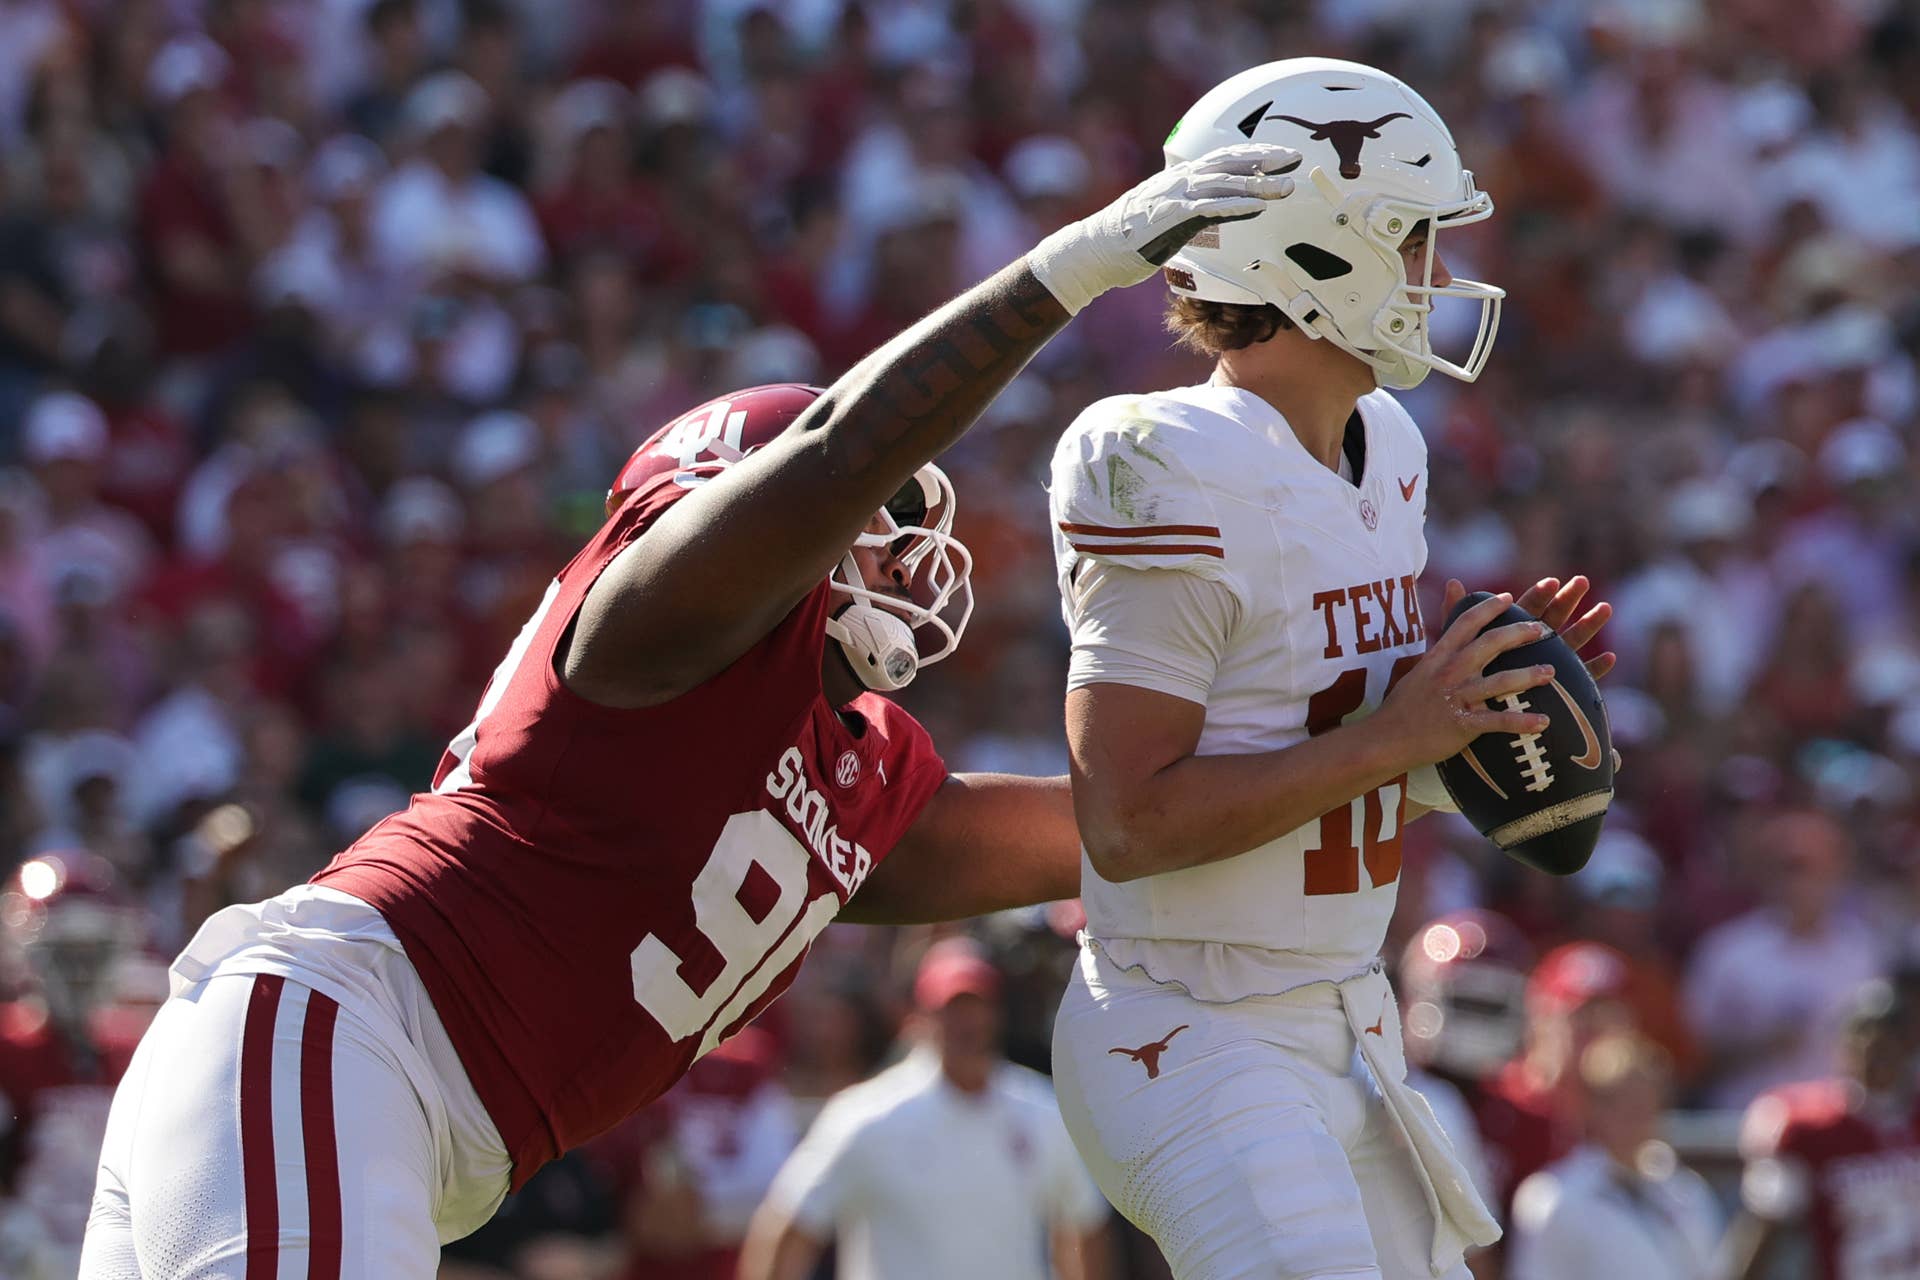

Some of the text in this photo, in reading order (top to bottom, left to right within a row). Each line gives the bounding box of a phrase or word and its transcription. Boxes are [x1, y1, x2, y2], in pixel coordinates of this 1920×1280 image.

[1313, 574, 1424, 659] TEXA
[837, 750, 860, 788] SEC
[766, 746, 877, 904] SOONER
